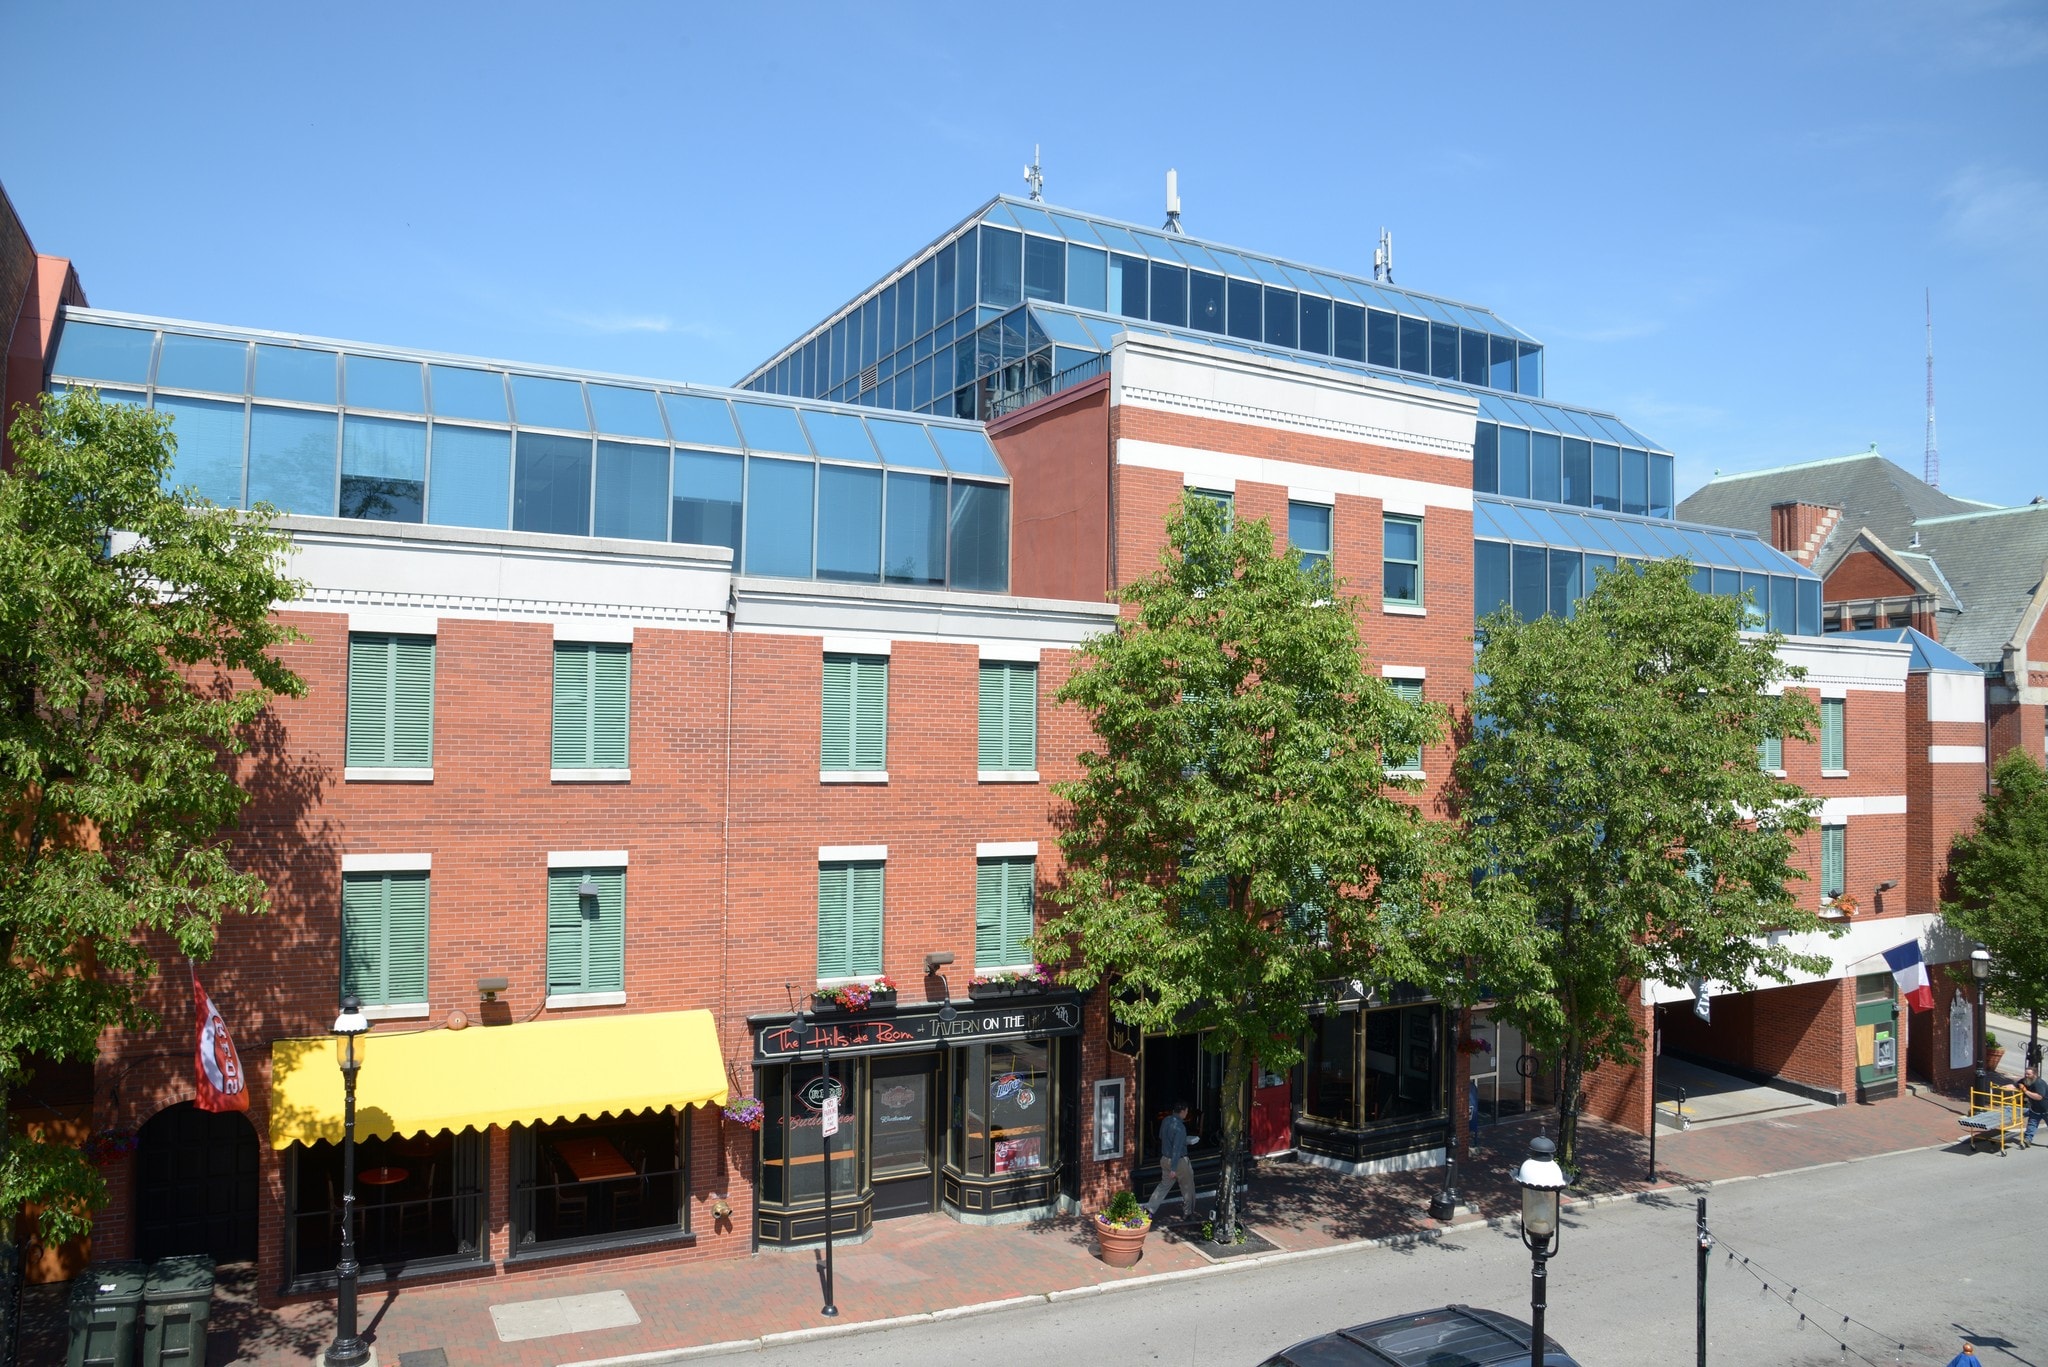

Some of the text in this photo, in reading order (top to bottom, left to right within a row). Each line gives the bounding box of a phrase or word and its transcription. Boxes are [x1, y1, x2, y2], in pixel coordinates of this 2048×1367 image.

[767, 1028, 800, 1052] The
[868, 1021, 914, 1043] Room
[929, 1018, 980, 1036] TAVERN
[983, 1017, 1000, 1031] ON
[1003, 1014, 1025, 1029] THE
